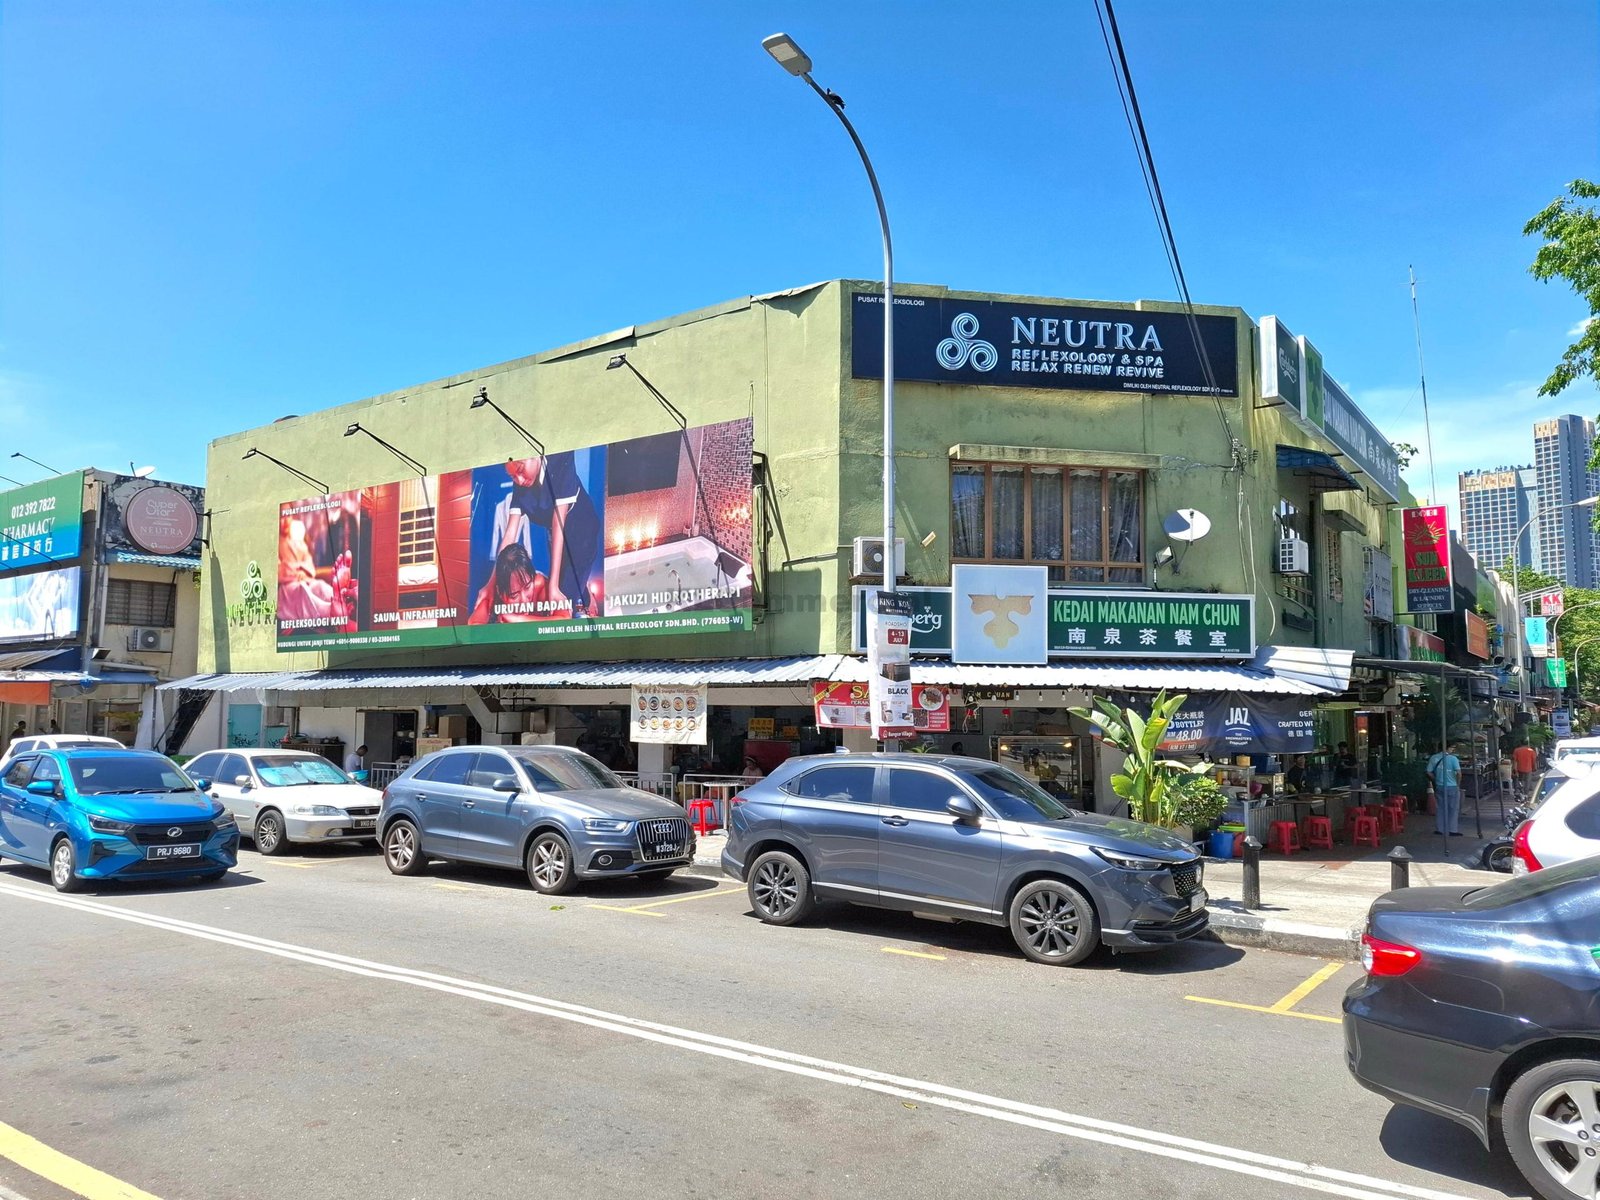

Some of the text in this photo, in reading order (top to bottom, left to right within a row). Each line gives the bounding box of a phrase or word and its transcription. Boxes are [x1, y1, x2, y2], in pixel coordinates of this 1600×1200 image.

[1011, 316, 1164, 352] NEUTRA
[1011, 349, 1164, 367] REFLEXOLOGY & SPA
[1011, 360, 1164, 379] RELAX RENEW REVIVE
[1171, 385, 1201, 393] REFLEXOLOGY
[11, 496, 56, 519] 012 392 7822
[282, 499, 341, 516] PUSAT REFLEKSOLOGI
[2, 517, 56, 543] PHARMACY
[140, 525, 183, 537] NEUTRA
[1415, 551, 1438, 566] SUN
[1407, 566, 1447, 582] KLEEN
[609, 587, 741, 609] JAKUZI HIDROTHERAPI
[879, 598, 895, 608] KING
[373, 607, 457, 623] SAUNA INFRAMERAH
[494, 599, 573, 615] URUTAN BADAN
[1053, 600, 1240, 626] KEDAI MAKANAN NAM CHUN
[280, 616, 348, 630] REFLEKSOLOGI KAKI
[538, 625, 566, 635] DIMILIKI
[566, 624, 583, 634] OLEH
[583, 622, 614, 633] NEUTRAL
[615, 620, 664, 631] REFLEXOLOGY
[701, 615, 744, 626] (776053-W)
[1068, 627, 1227, 647] 南泉茶餐室
[887, 687, 909, 695] BLACK
[1175, 719, 1205, 729] BOTTLES
[1225, 707, 1251, 726] JAZ
[1176, 729, 1203, 741] 48.00
[157, 846, 192, 857] PRJ 9680
